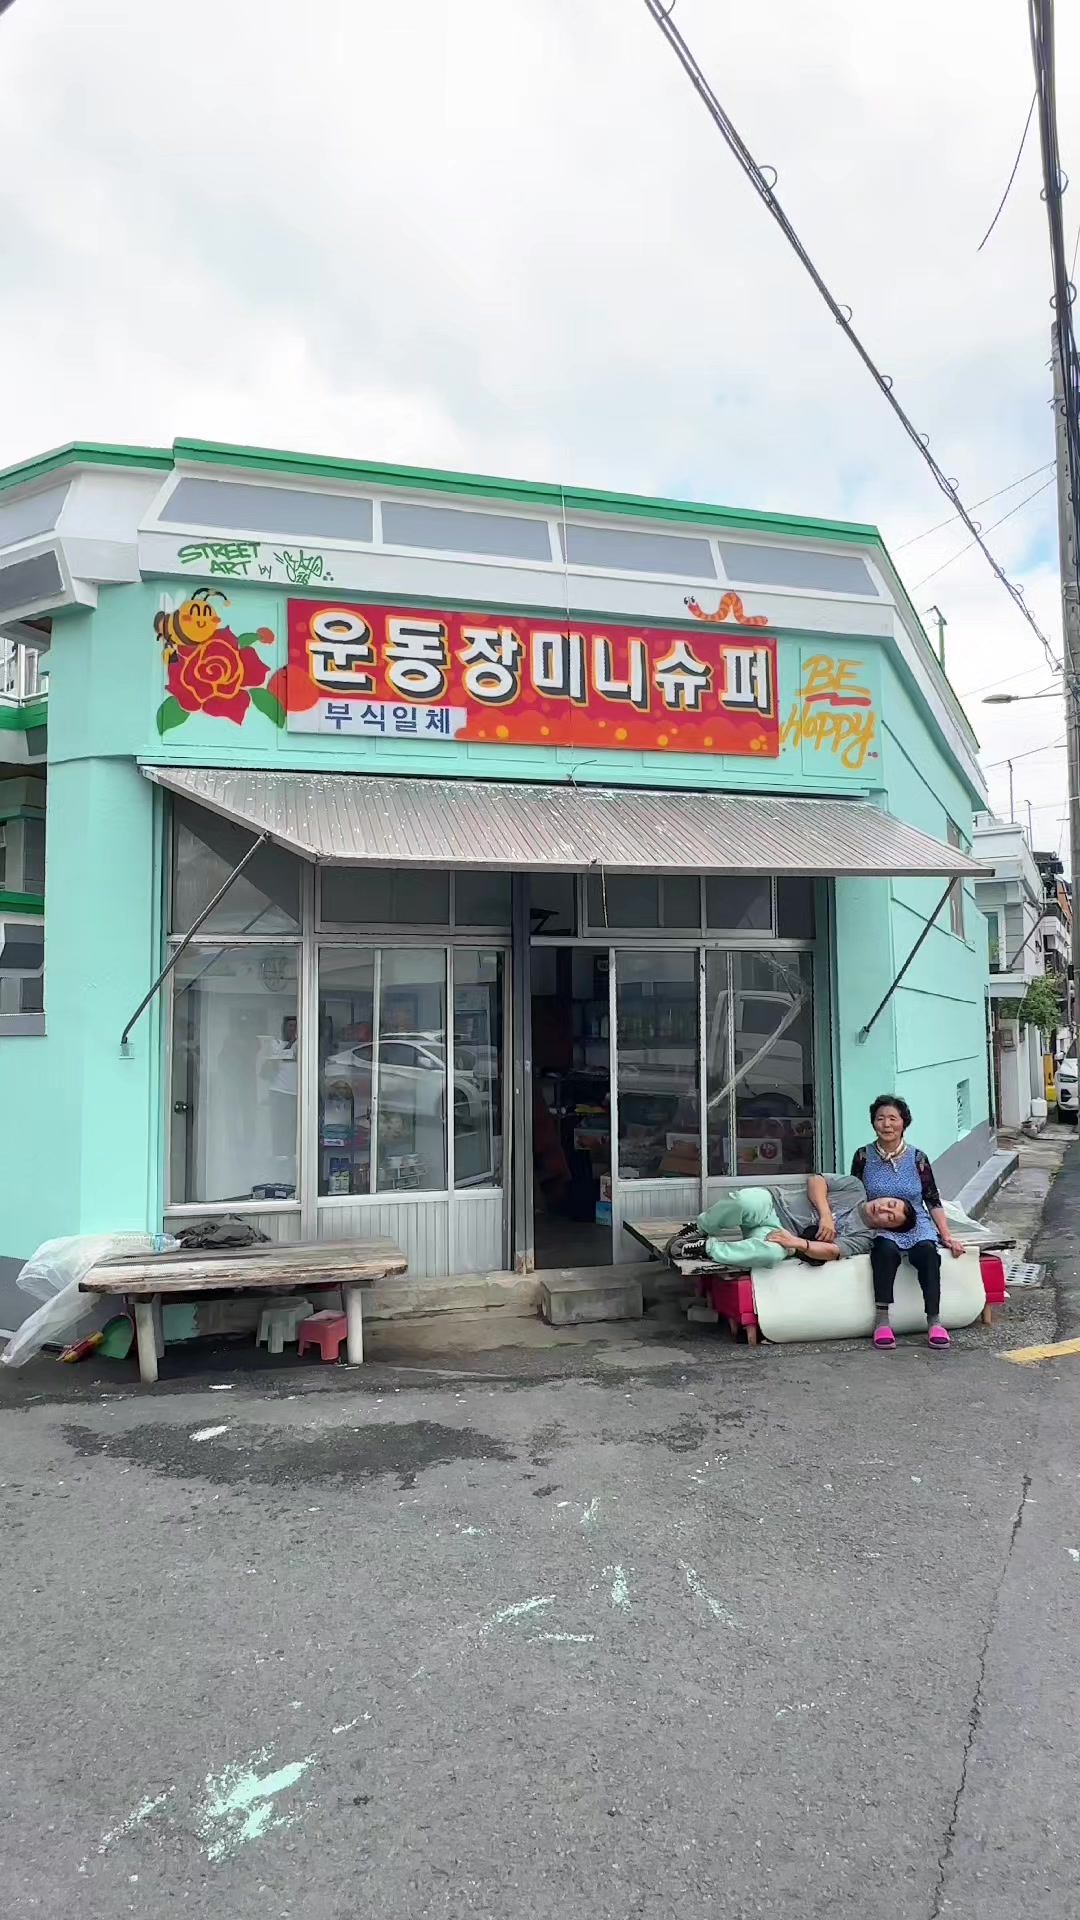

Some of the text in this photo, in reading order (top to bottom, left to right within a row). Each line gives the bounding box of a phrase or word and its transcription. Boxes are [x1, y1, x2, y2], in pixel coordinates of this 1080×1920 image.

[177, 542, 262, 565] STREET
[210, 559, 251, 576] ART
[258, 563, 272, 580] by
[306, 607, 775, 719] 운동장미니슈퍼
[795, 653, 872, 697] BE
[325, 702, 451, 735] 부식일체
[780, 703, 876, 770] Happy
